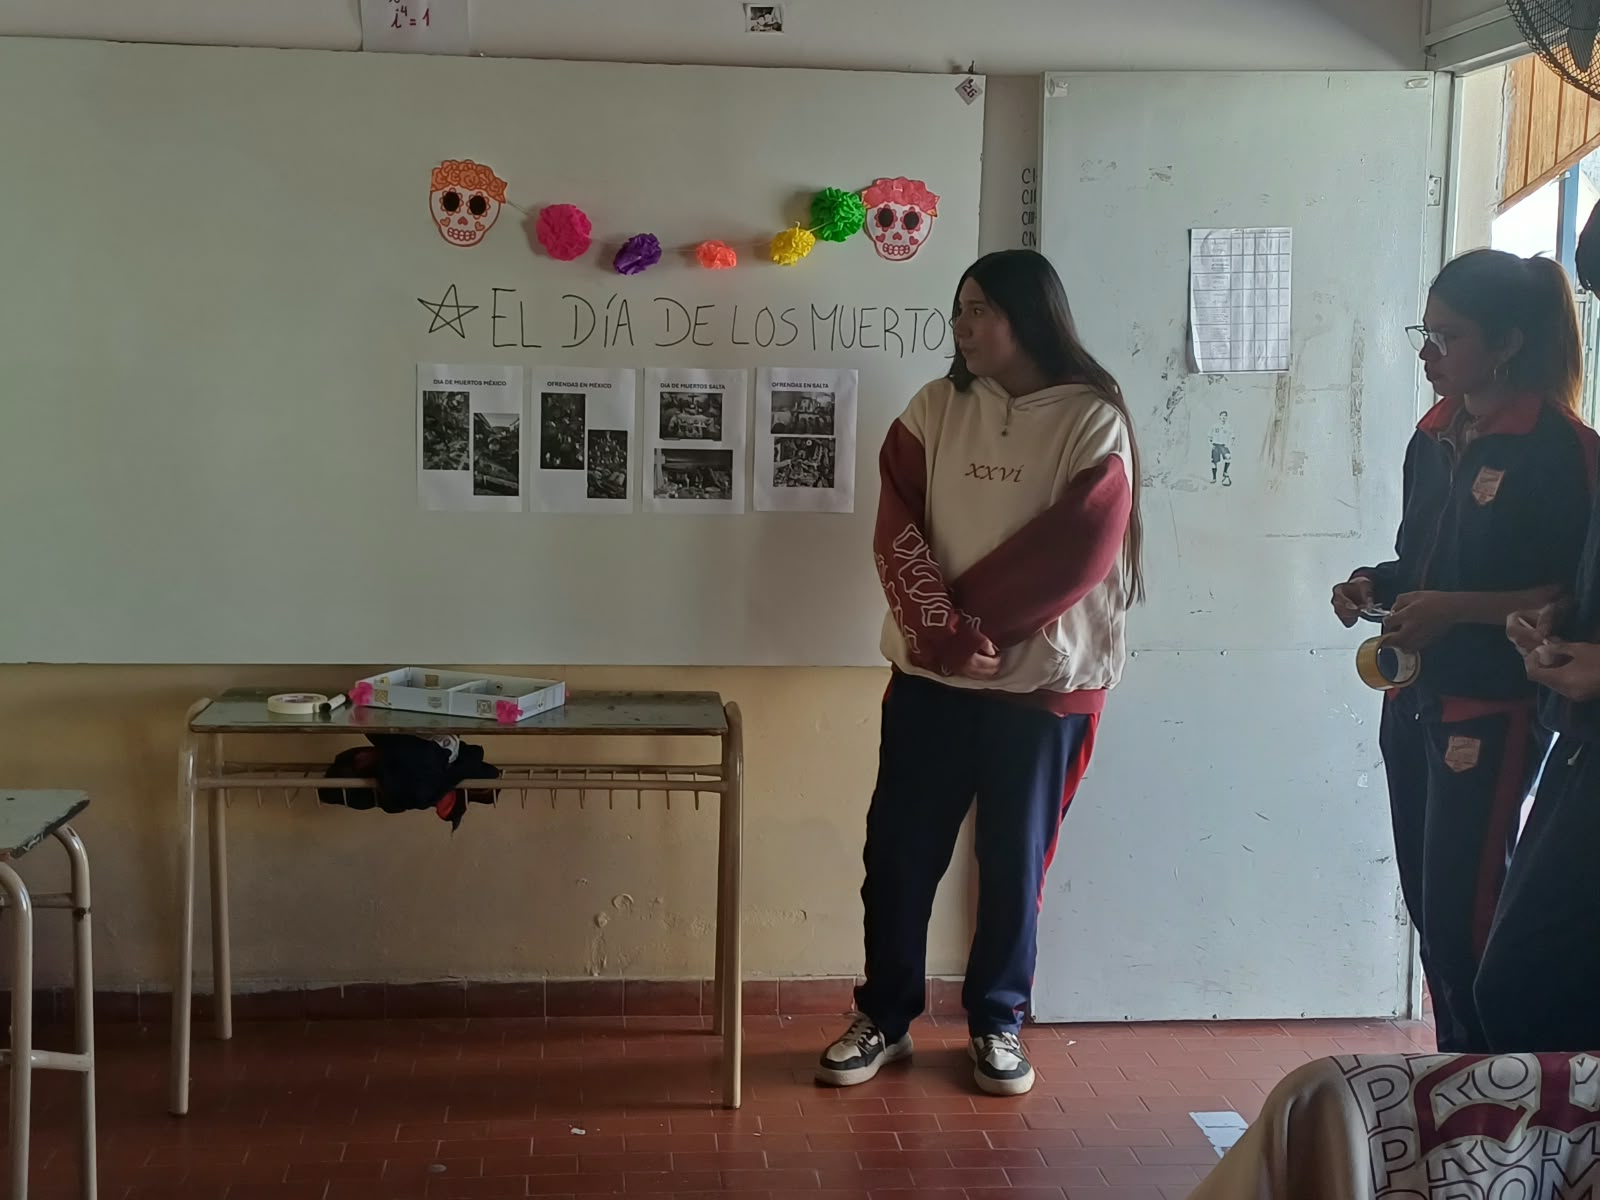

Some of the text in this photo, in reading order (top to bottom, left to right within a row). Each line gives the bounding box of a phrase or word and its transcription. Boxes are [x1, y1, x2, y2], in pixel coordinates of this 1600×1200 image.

[409, 18, 417, 26] =
[422, 8, 430, 27] 1
[491, 287, 543, 348] EL
[561, 293, 634, 348] DÍA
[653, 297, 716, 347] DE
[731, 304, 799, 348] LOS
